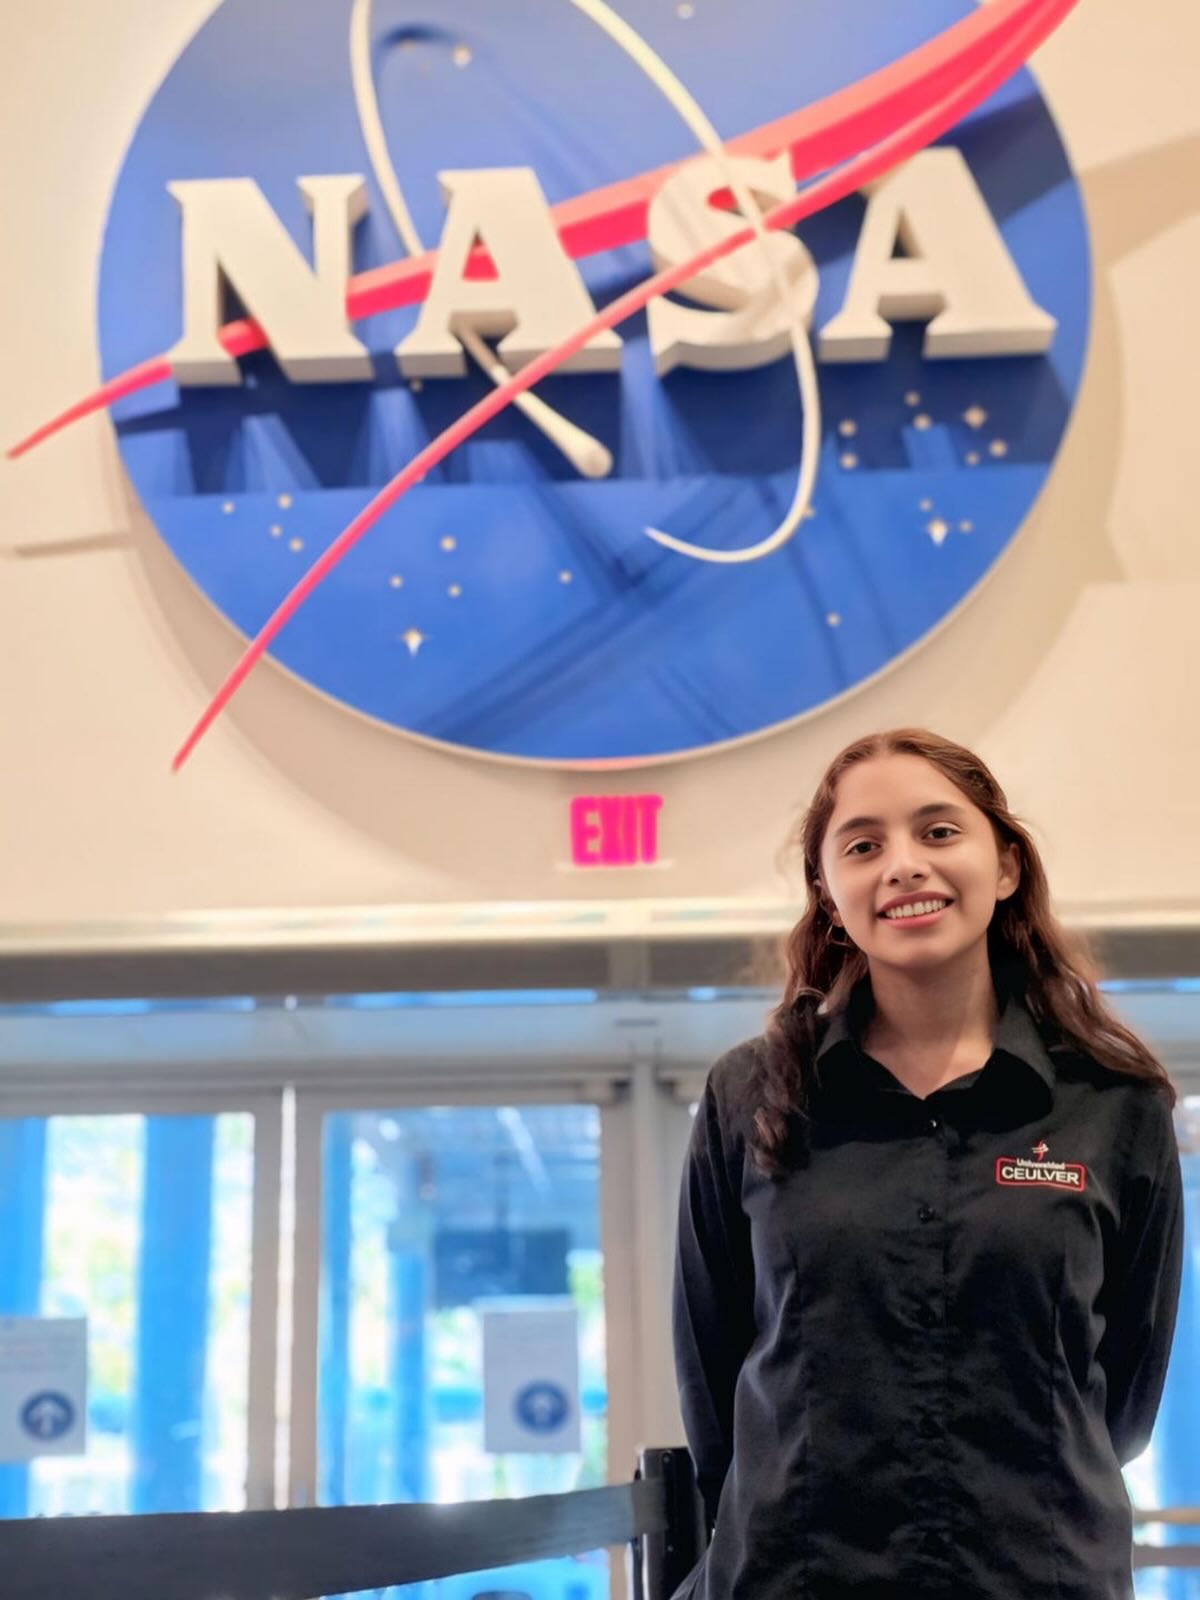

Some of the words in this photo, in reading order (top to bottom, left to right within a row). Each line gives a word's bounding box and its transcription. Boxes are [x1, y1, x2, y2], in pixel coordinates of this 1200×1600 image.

[167, 147, 1056, 385] NASA
[570, 795, 663, 866] EXIT
[1001, 1166, 1079, 1185] CEULVER
